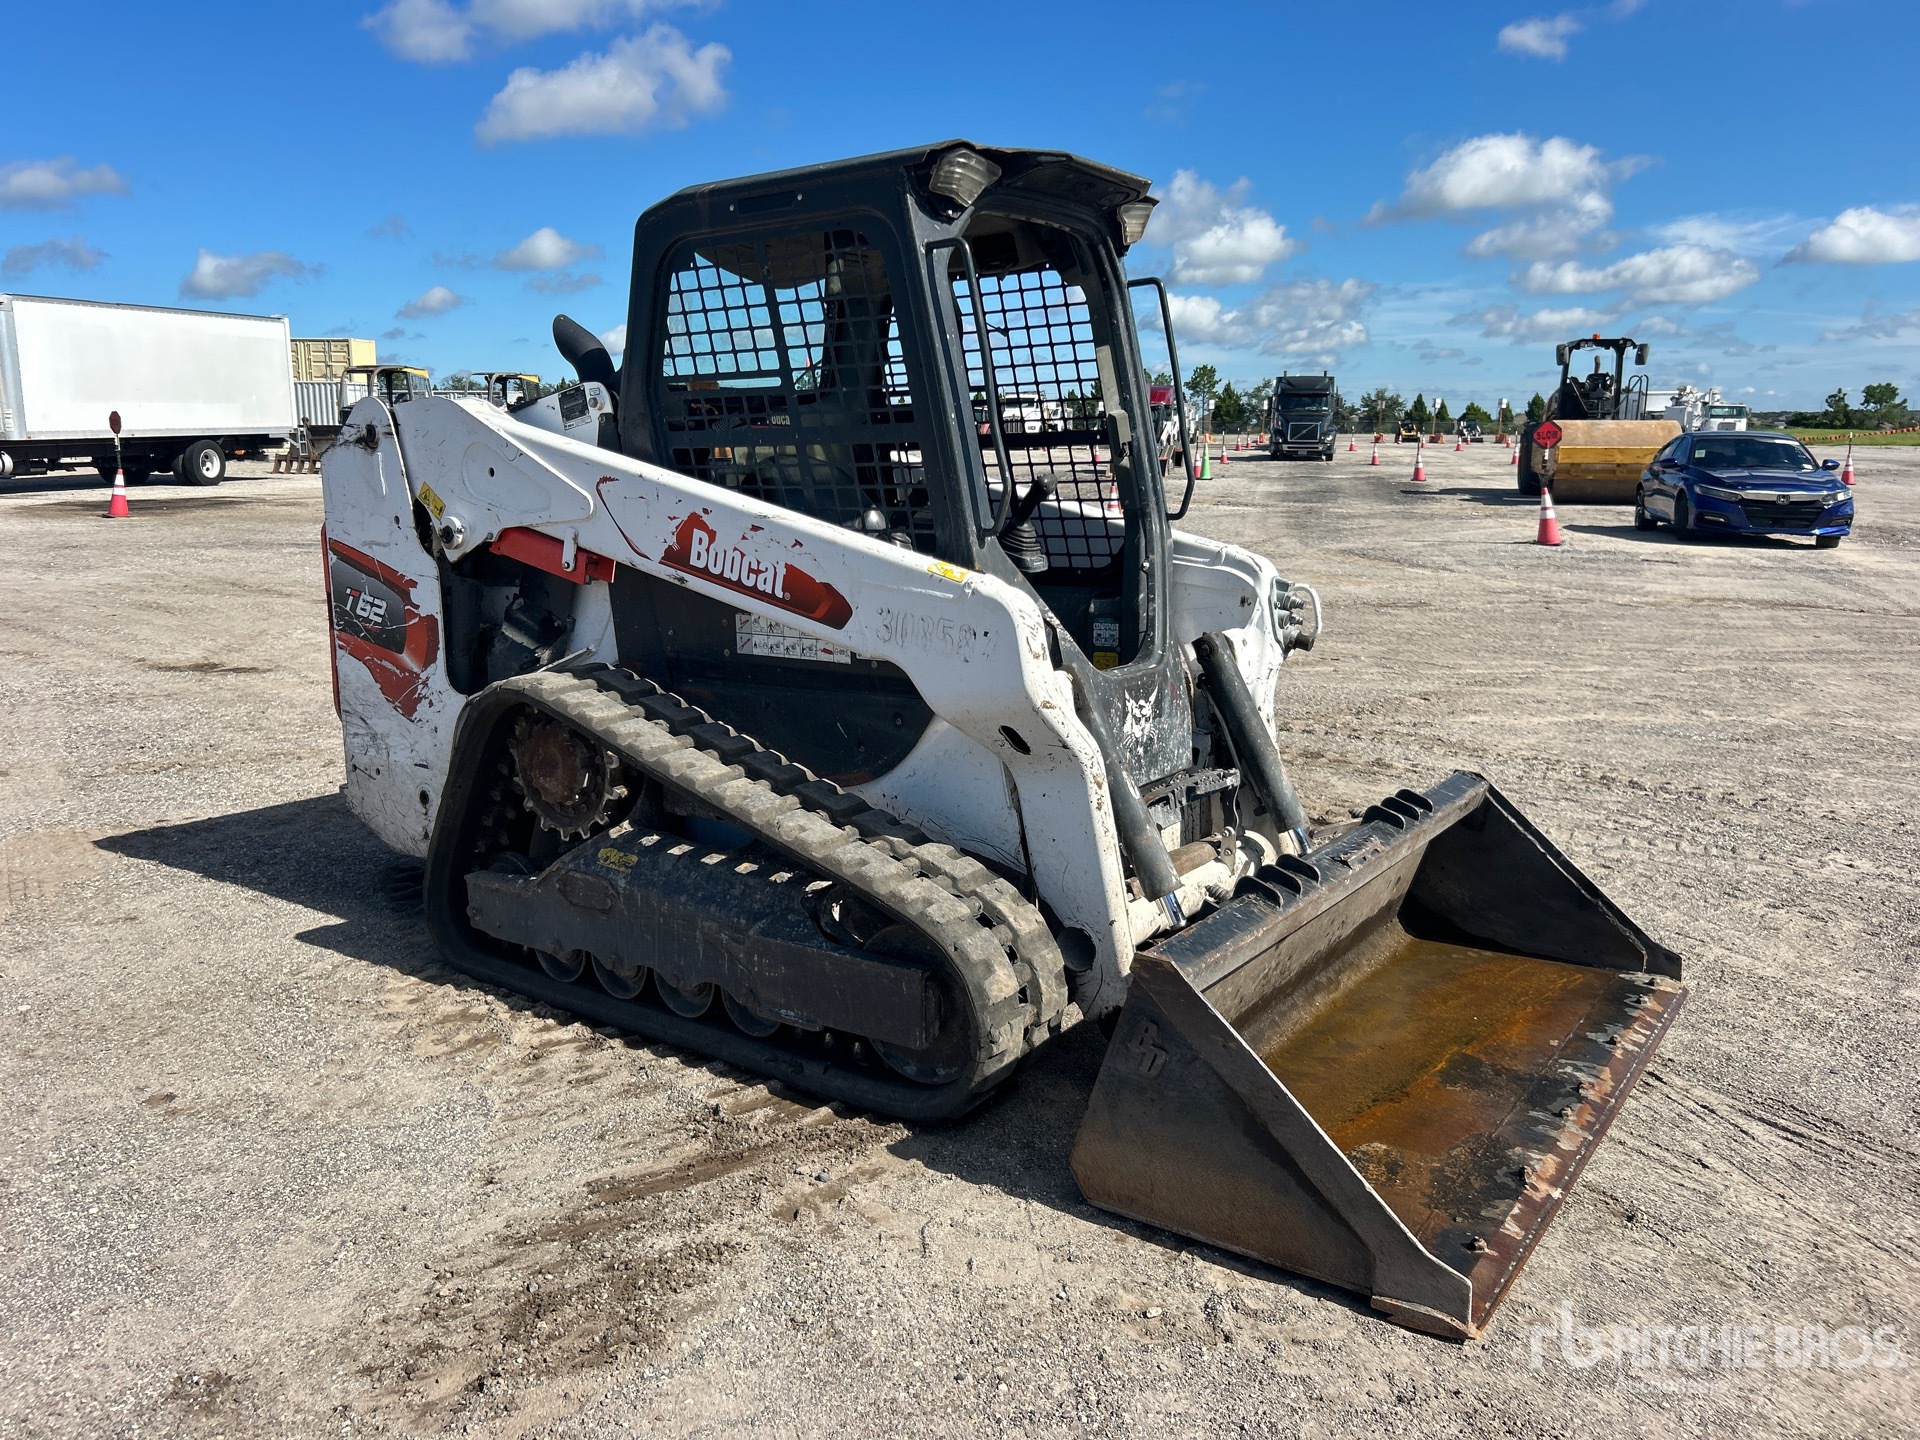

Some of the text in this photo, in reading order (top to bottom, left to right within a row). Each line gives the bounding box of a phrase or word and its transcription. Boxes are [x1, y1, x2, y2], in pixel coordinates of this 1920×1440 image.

[767, 414, 791, 426] obca
[1535, 430, 1559, 441] SLOW
[689, 527, 786, 599] Bobcat
[345, 587, 387, 624] T62
